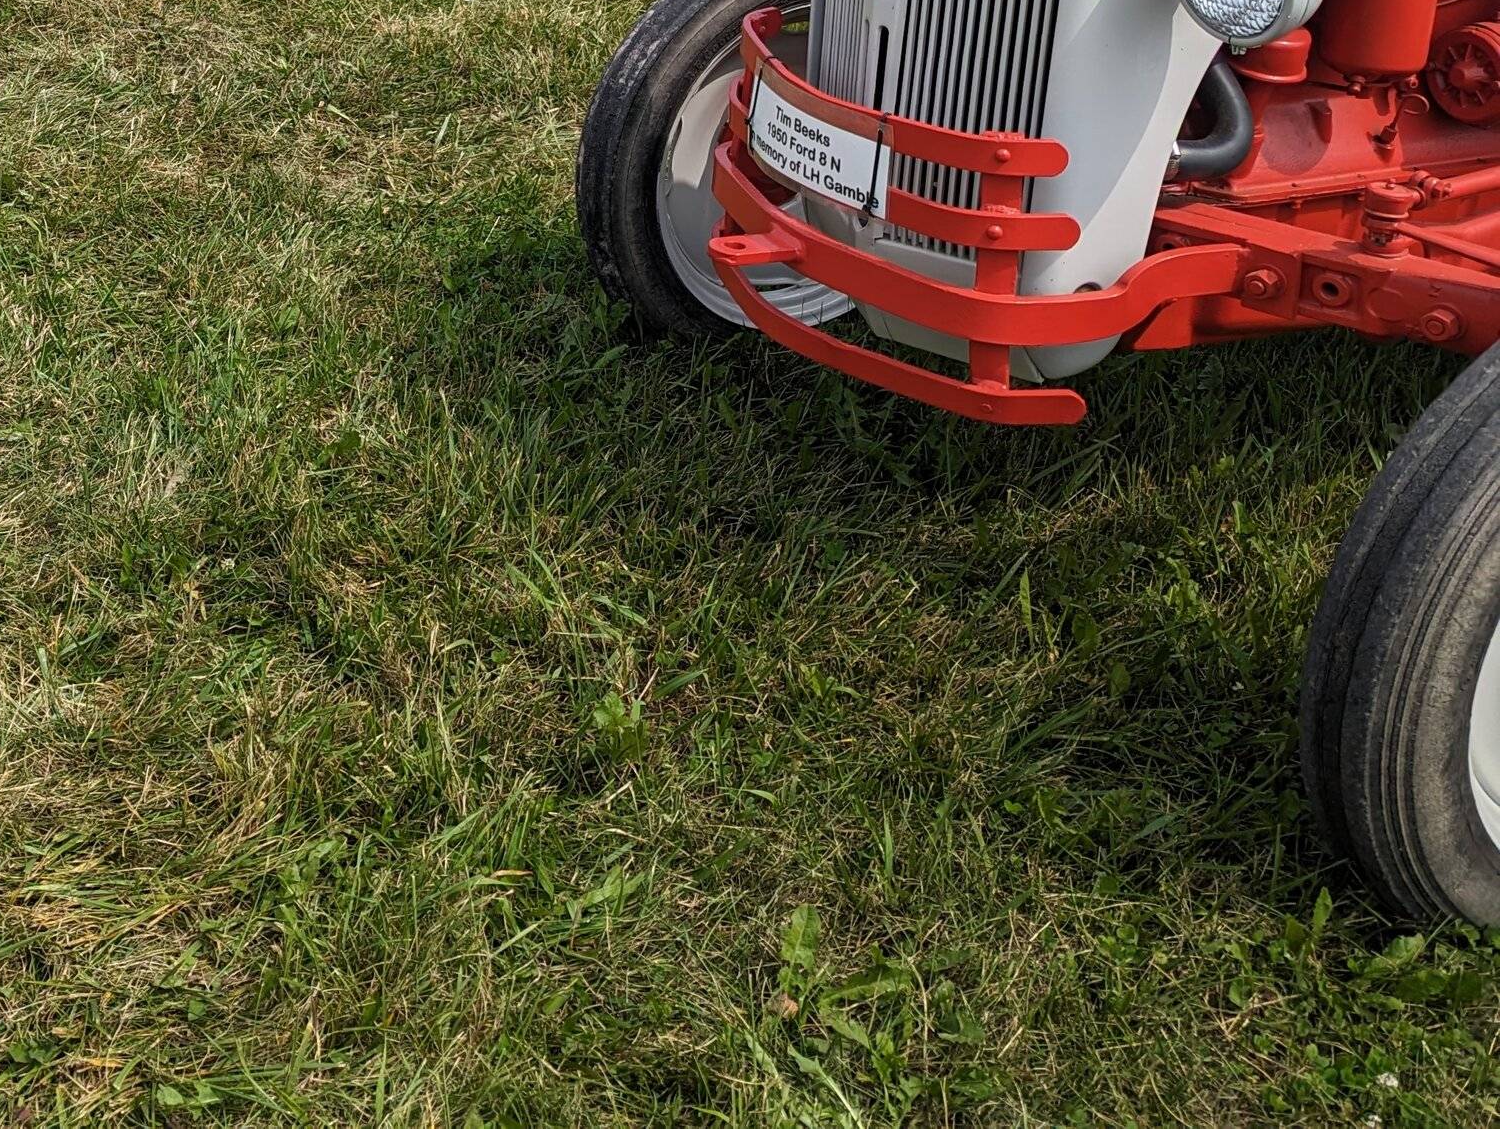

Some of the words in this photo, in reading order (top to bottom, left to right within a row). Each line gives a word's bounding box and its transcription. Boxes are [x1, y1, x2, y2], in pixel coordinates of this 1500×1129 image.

[767, 121, 788, 146] 1950
[790, 136, 816, 162] Ford
[819, 152, 827, 167] 8
[831, 156, 841, 174] N
[776, 105, 792, 129] Tim
[794, 118, 830, 147] Beeks
[757, 134, 788, 169] memory
[789, 160, 802, 175] of
[803, 164, 820, 185] LH
[824, 175, 880, 209] Gamble
